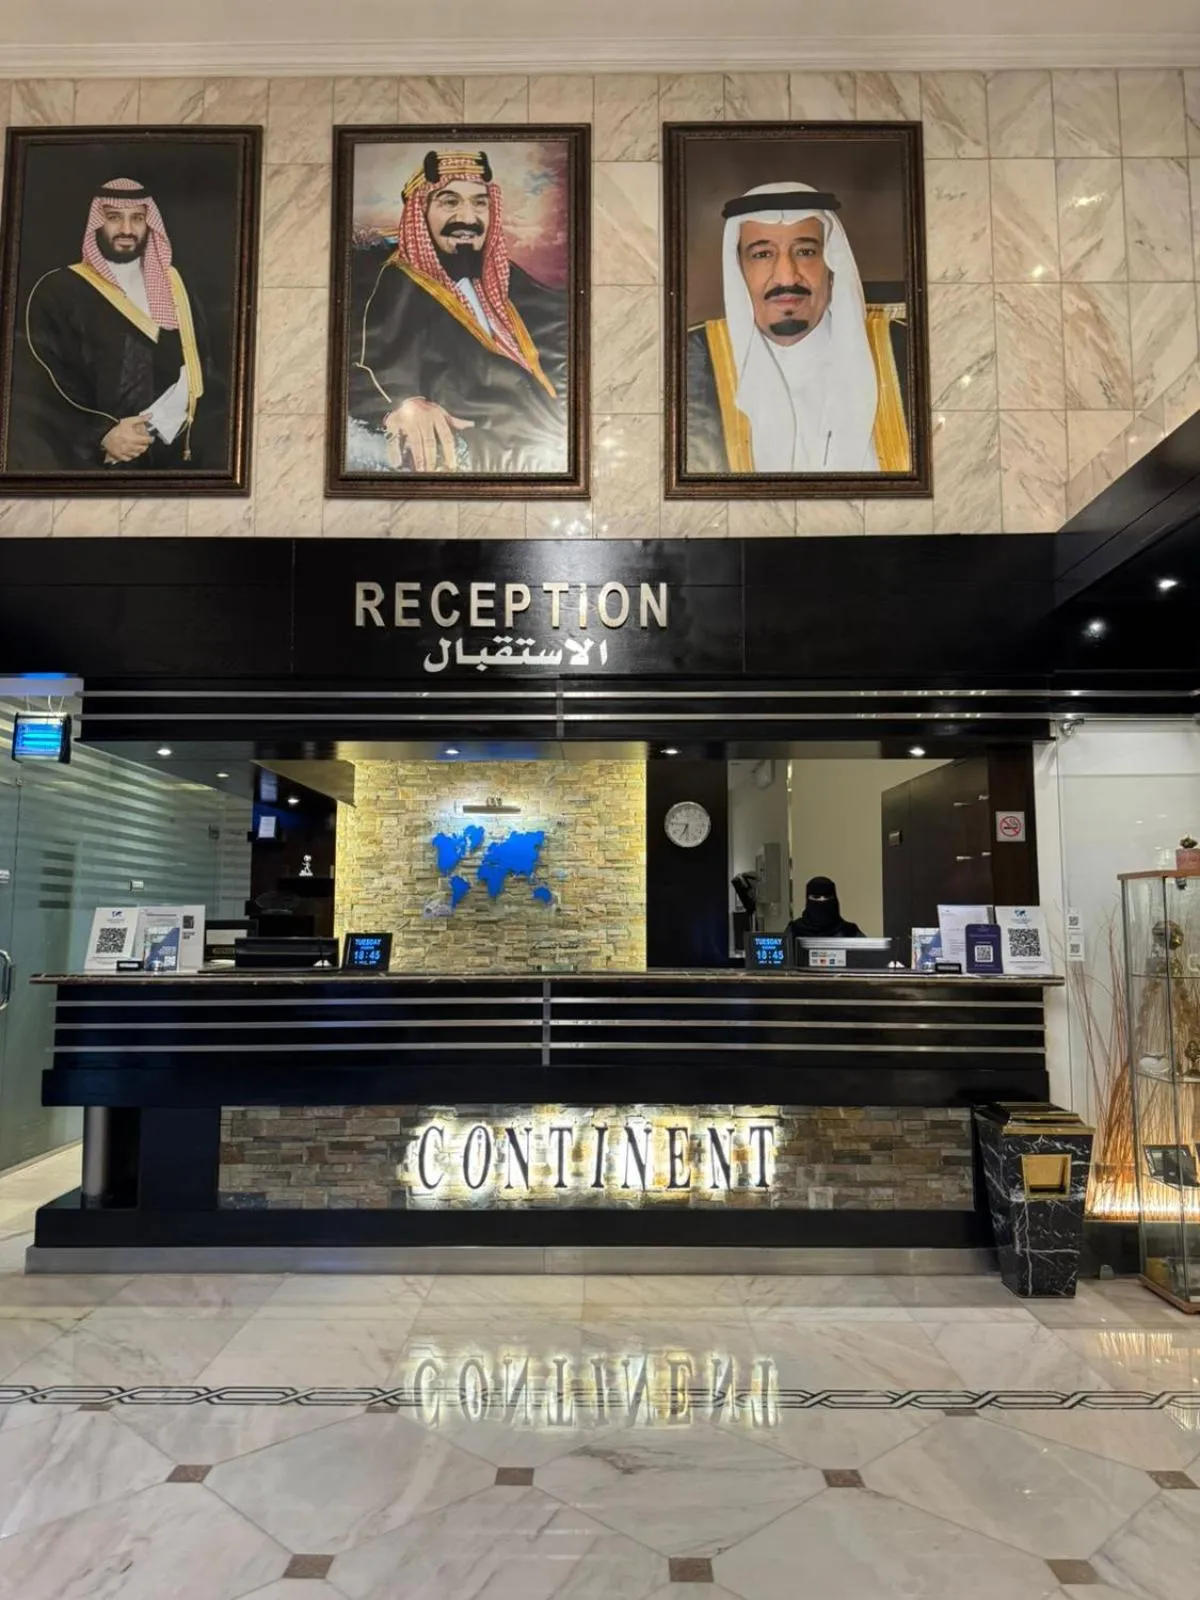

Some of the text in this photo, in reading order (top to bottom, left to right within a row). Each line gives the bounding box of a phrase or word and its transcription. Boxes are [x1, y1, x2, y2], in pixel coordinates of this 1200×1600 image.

[354, 581, 669, 630] RECEPTION
[423, 635, 609, 673] الاستقبال
[755, 937, 783, 946] TUESDAY
[417, 1124, 775, 1190] CONTINENT
